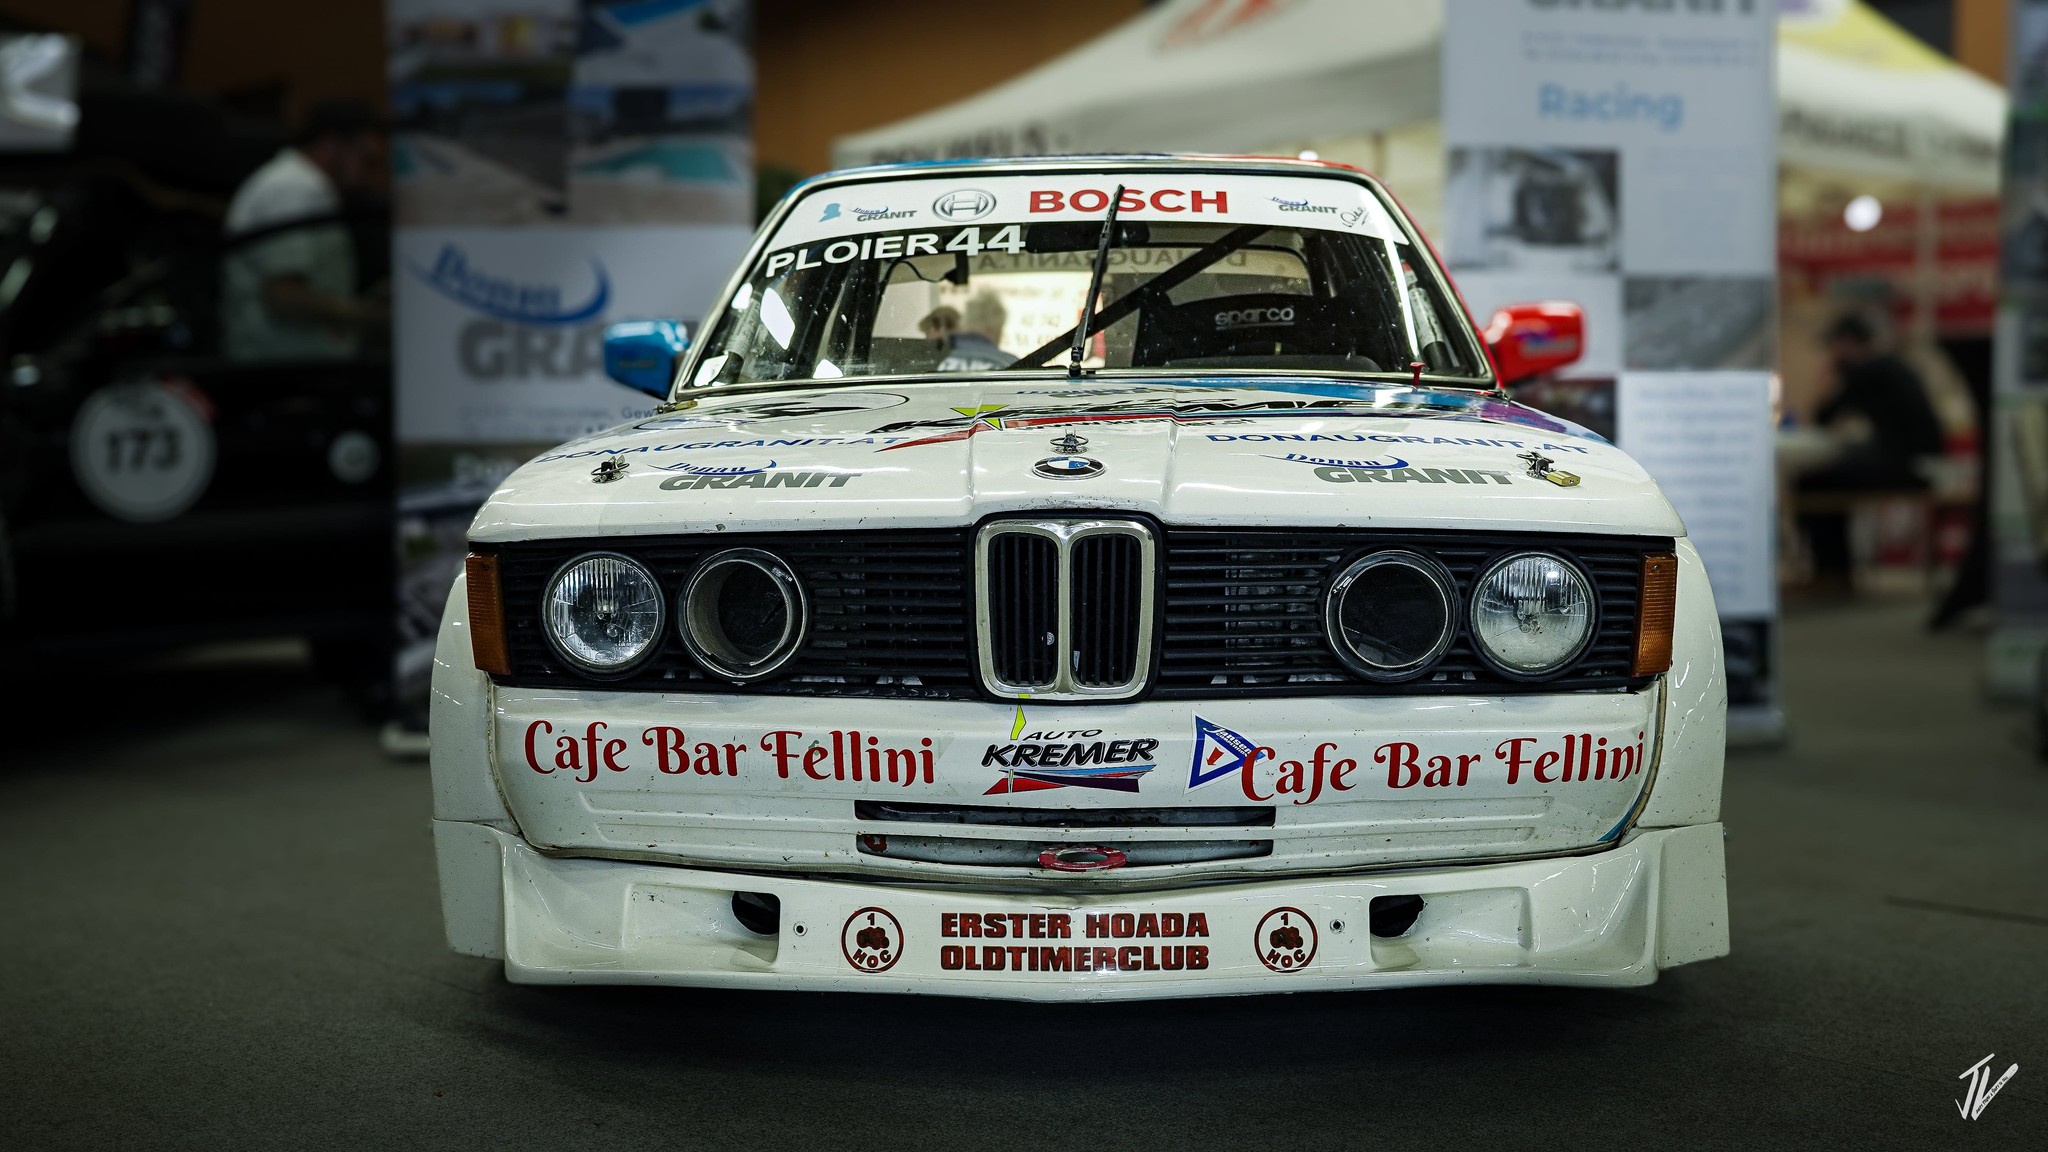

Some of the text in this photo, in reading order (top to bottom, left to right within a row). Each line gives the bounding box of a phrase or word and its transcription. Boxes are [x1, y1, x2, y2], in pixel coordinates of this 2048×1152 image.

[1539, 81, 1684, 131] Racing
[1029, 189, 1228, 213] BOSCH
[1278, 204, 1338, 214] GRANIT
[856, 210, 918, 223] GRANIT
[765, 226, 1026, 278] PLOIER 44
[1215, 307, 1295, 330] sparco
[102, 428, 184, 476] 173
[536, 436, 910, 463] DONAUGRANIT.AT
[1284, 452, 1382, 467] Donau
[659, 472, 863, 491] GRANIT
[1313, 466, 1513, 486] GRANIT
[1022, 729, 1103, 741] AUTO
[524, 720, 935, 788] Cafe Bar Fellini
[981, 738, 1160, 767] KREMER
[1240, 731, 1645, 806] Cafe Bar Fellini
[867, 913, 875, 926] 1
[941, 911, 1210, 939] ERSTER HOADA
[1280, 912, 1289, 926] 1
[940, 944, 1209, 972] OLDTIMERCLUB
